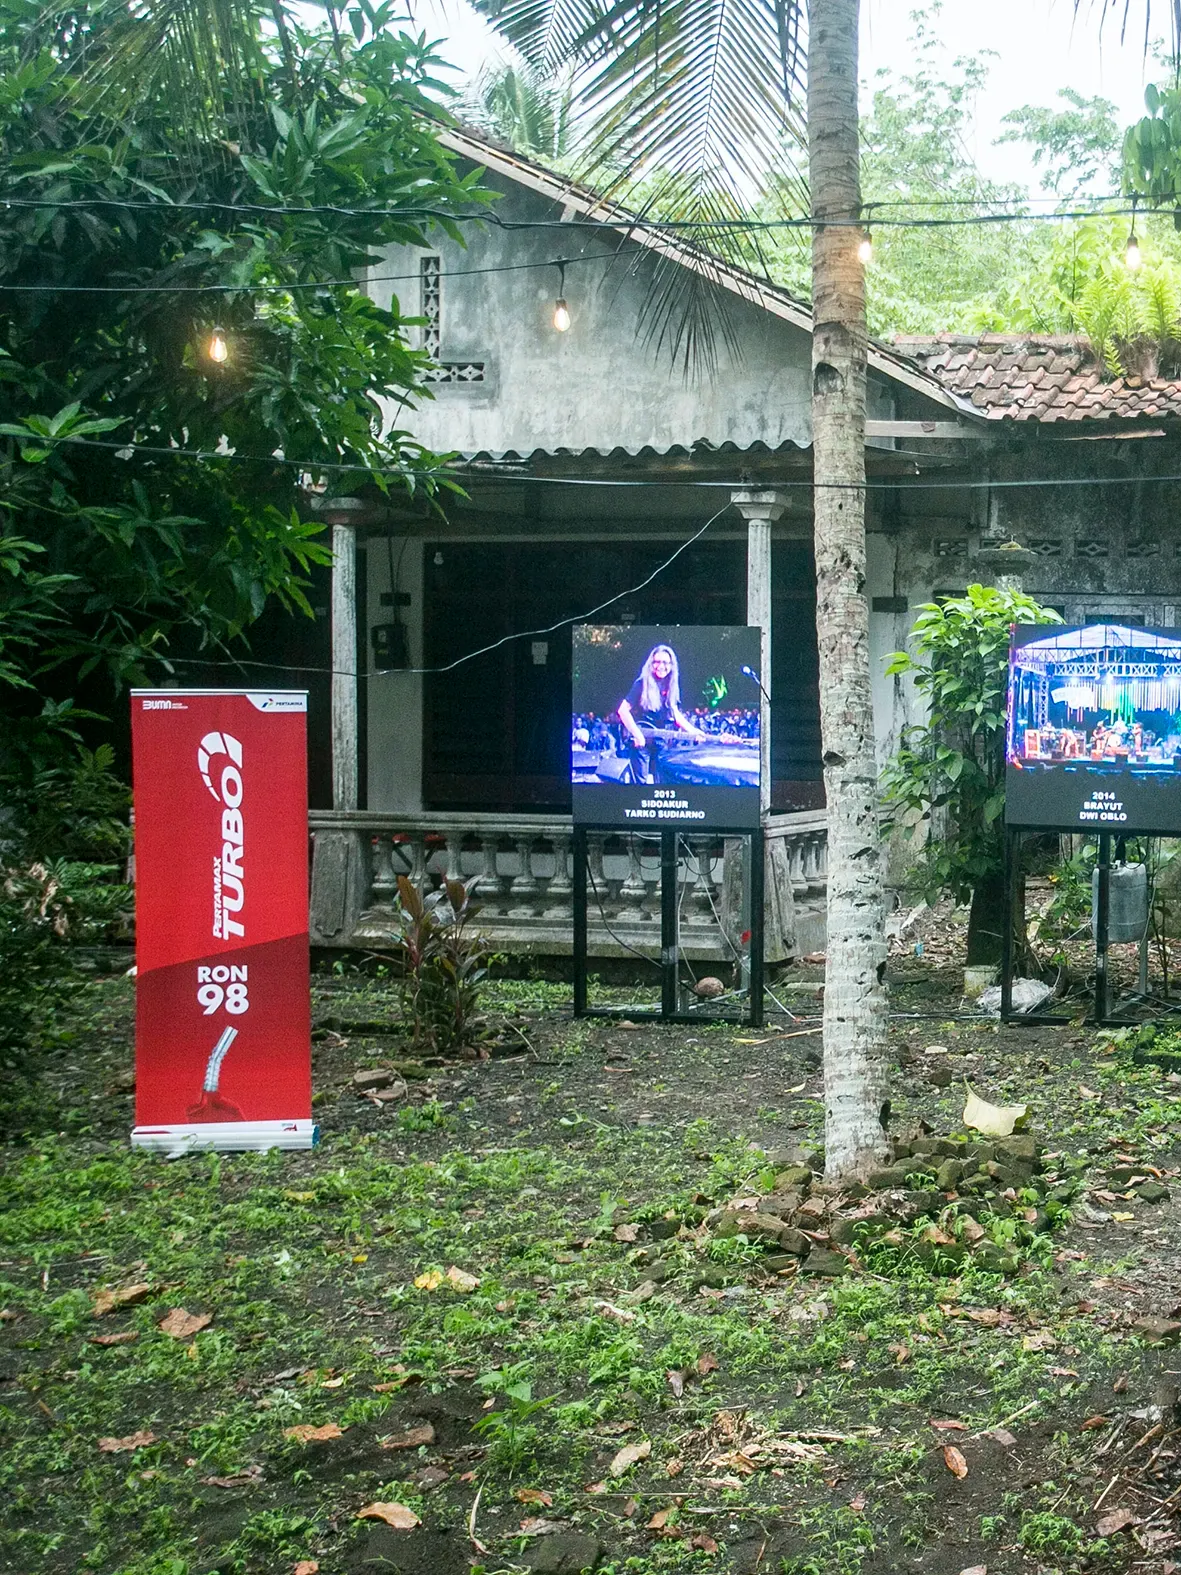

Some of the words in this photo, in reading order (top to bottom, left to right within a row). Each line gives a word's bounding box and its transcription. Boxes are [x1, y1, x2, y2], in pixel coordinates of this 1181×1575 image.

[654, 790, 676, 799] 2013
[1092, 791, 1116, 800] 2014
[641, 800, 689, 809] SIDOAKUR
[1084, 801, 1123, 811] BRAYUT
[625, 809, 656, 818] TARKO
[658, 810, 706, 819] SUDIARNO
[1079, 811, 1099, 820] DWI
[1100, 812, 1128, 821] OBLO
[221, 765, 245, 941] TURBO
[212, 857, 222, 939] PERTAMAX
[197, 965, 248, 983] RON
[196, 982, 250, 1016] 98
